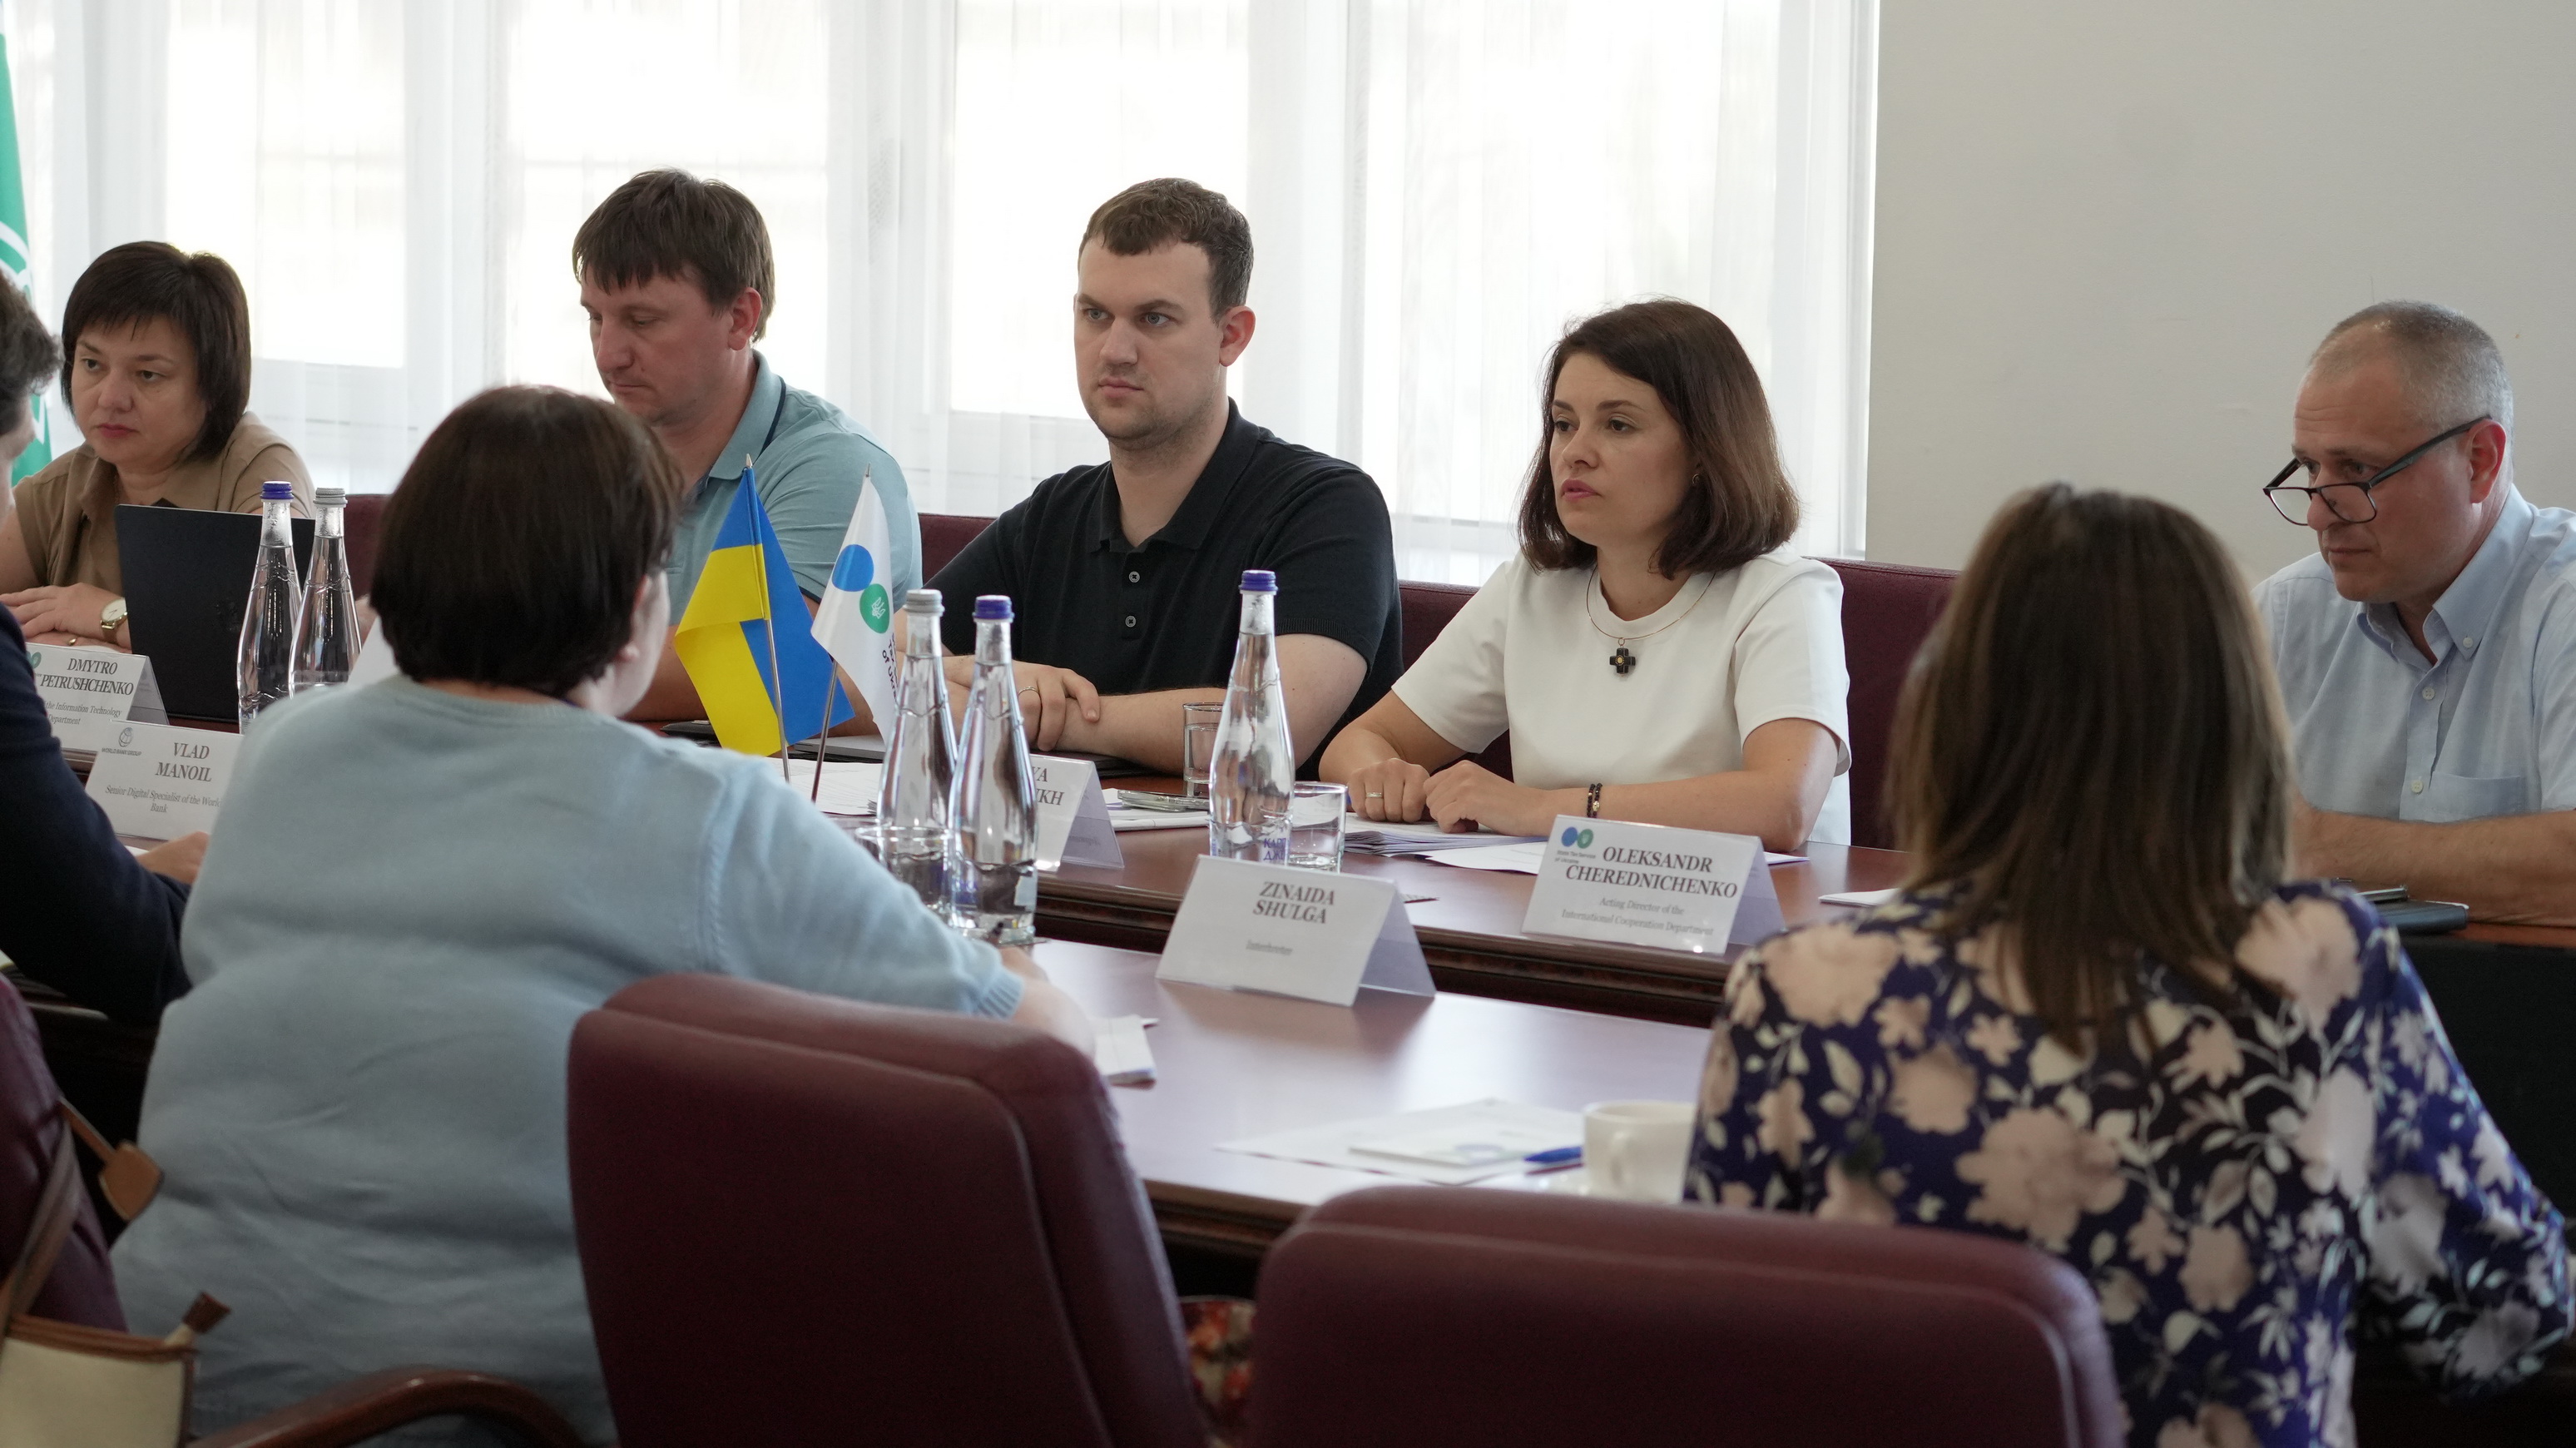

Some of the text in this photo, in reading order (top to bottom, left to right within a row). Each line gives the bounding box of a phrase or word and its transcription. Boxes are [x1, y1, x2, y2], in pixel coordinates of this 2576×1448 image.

[67, 658, 117, 675] DMYTRO
[40, 674, 134, 696] PETRUSHCHENKO
[46, 701, 55, 710] the
[55, 702, 89, 713] Information
[90, 706, 122, 718] Technology
[173, 742, 210, 760] VLAD
[155, 761, 212, 782] MANOIL
[105, 785, 126, 796] Senior
[126, 787, 150, 799] Digital
[150, 790, 181, 801] Specialist
[181, 794, 191, 804] of
[190, 795, 201, 805] the
[151, 802, 167, 813] Bank
[1603, 845, 1713, 873] OLEKSANDR
[1566, 865, 1738, 899] CHEREDNICHENKO
[1259, 881, 1335, 905] ZINAIDA
[1252, 900, 1326, 924] SHULGA
[1599, 897, 1685, 915] Acting Director of the
[1562, 909, 1714, 936] International Cooperation Department
